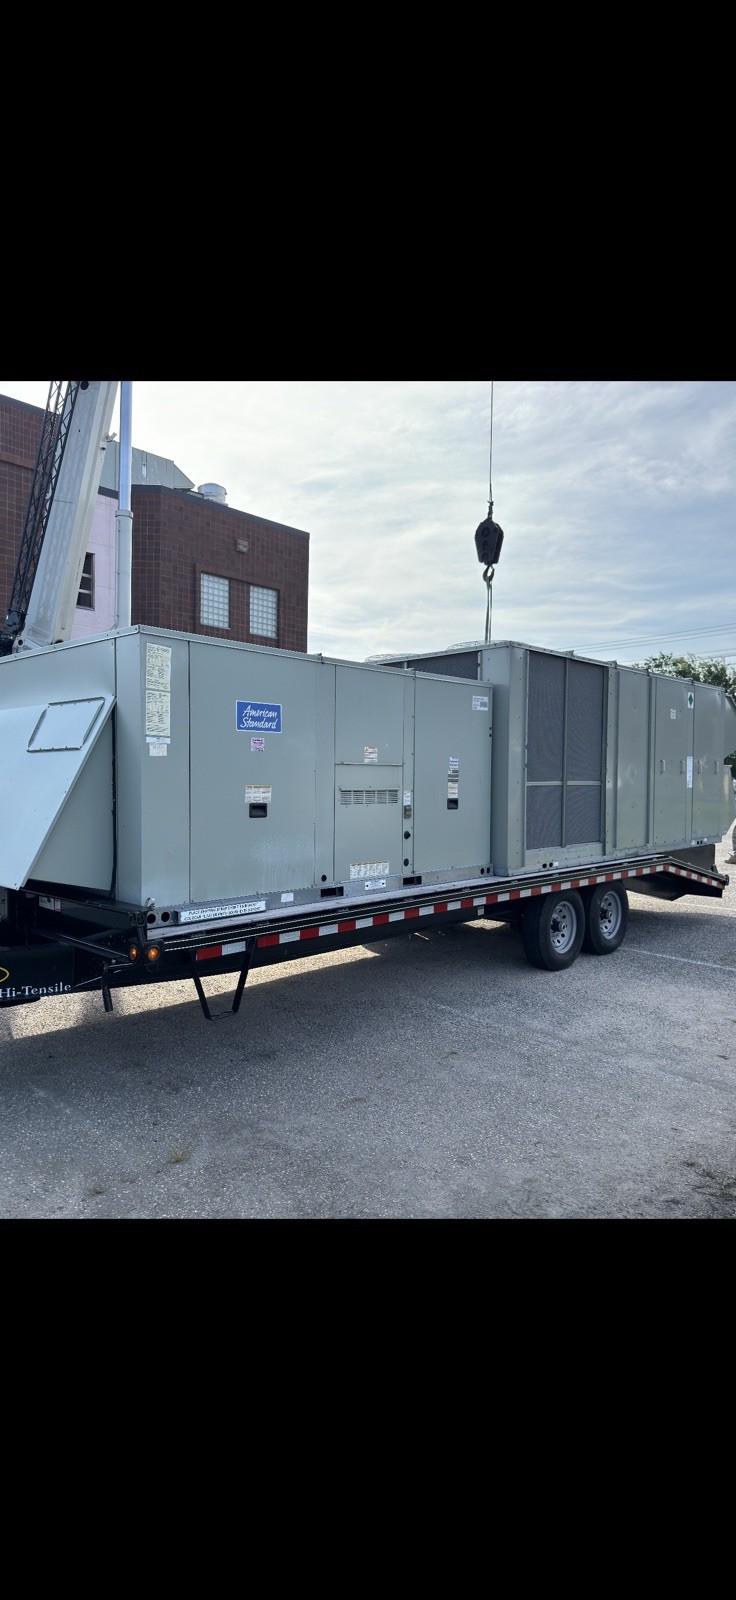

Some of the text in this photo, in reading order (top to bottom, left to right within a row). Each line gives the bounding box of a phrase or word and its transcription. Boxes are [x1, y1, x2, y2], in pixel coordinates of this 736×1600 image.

[242, 705, 278, 718] American
[240, 717, 279, 729] Standard
[0, 982, 71, 998] Hi-Tensile
